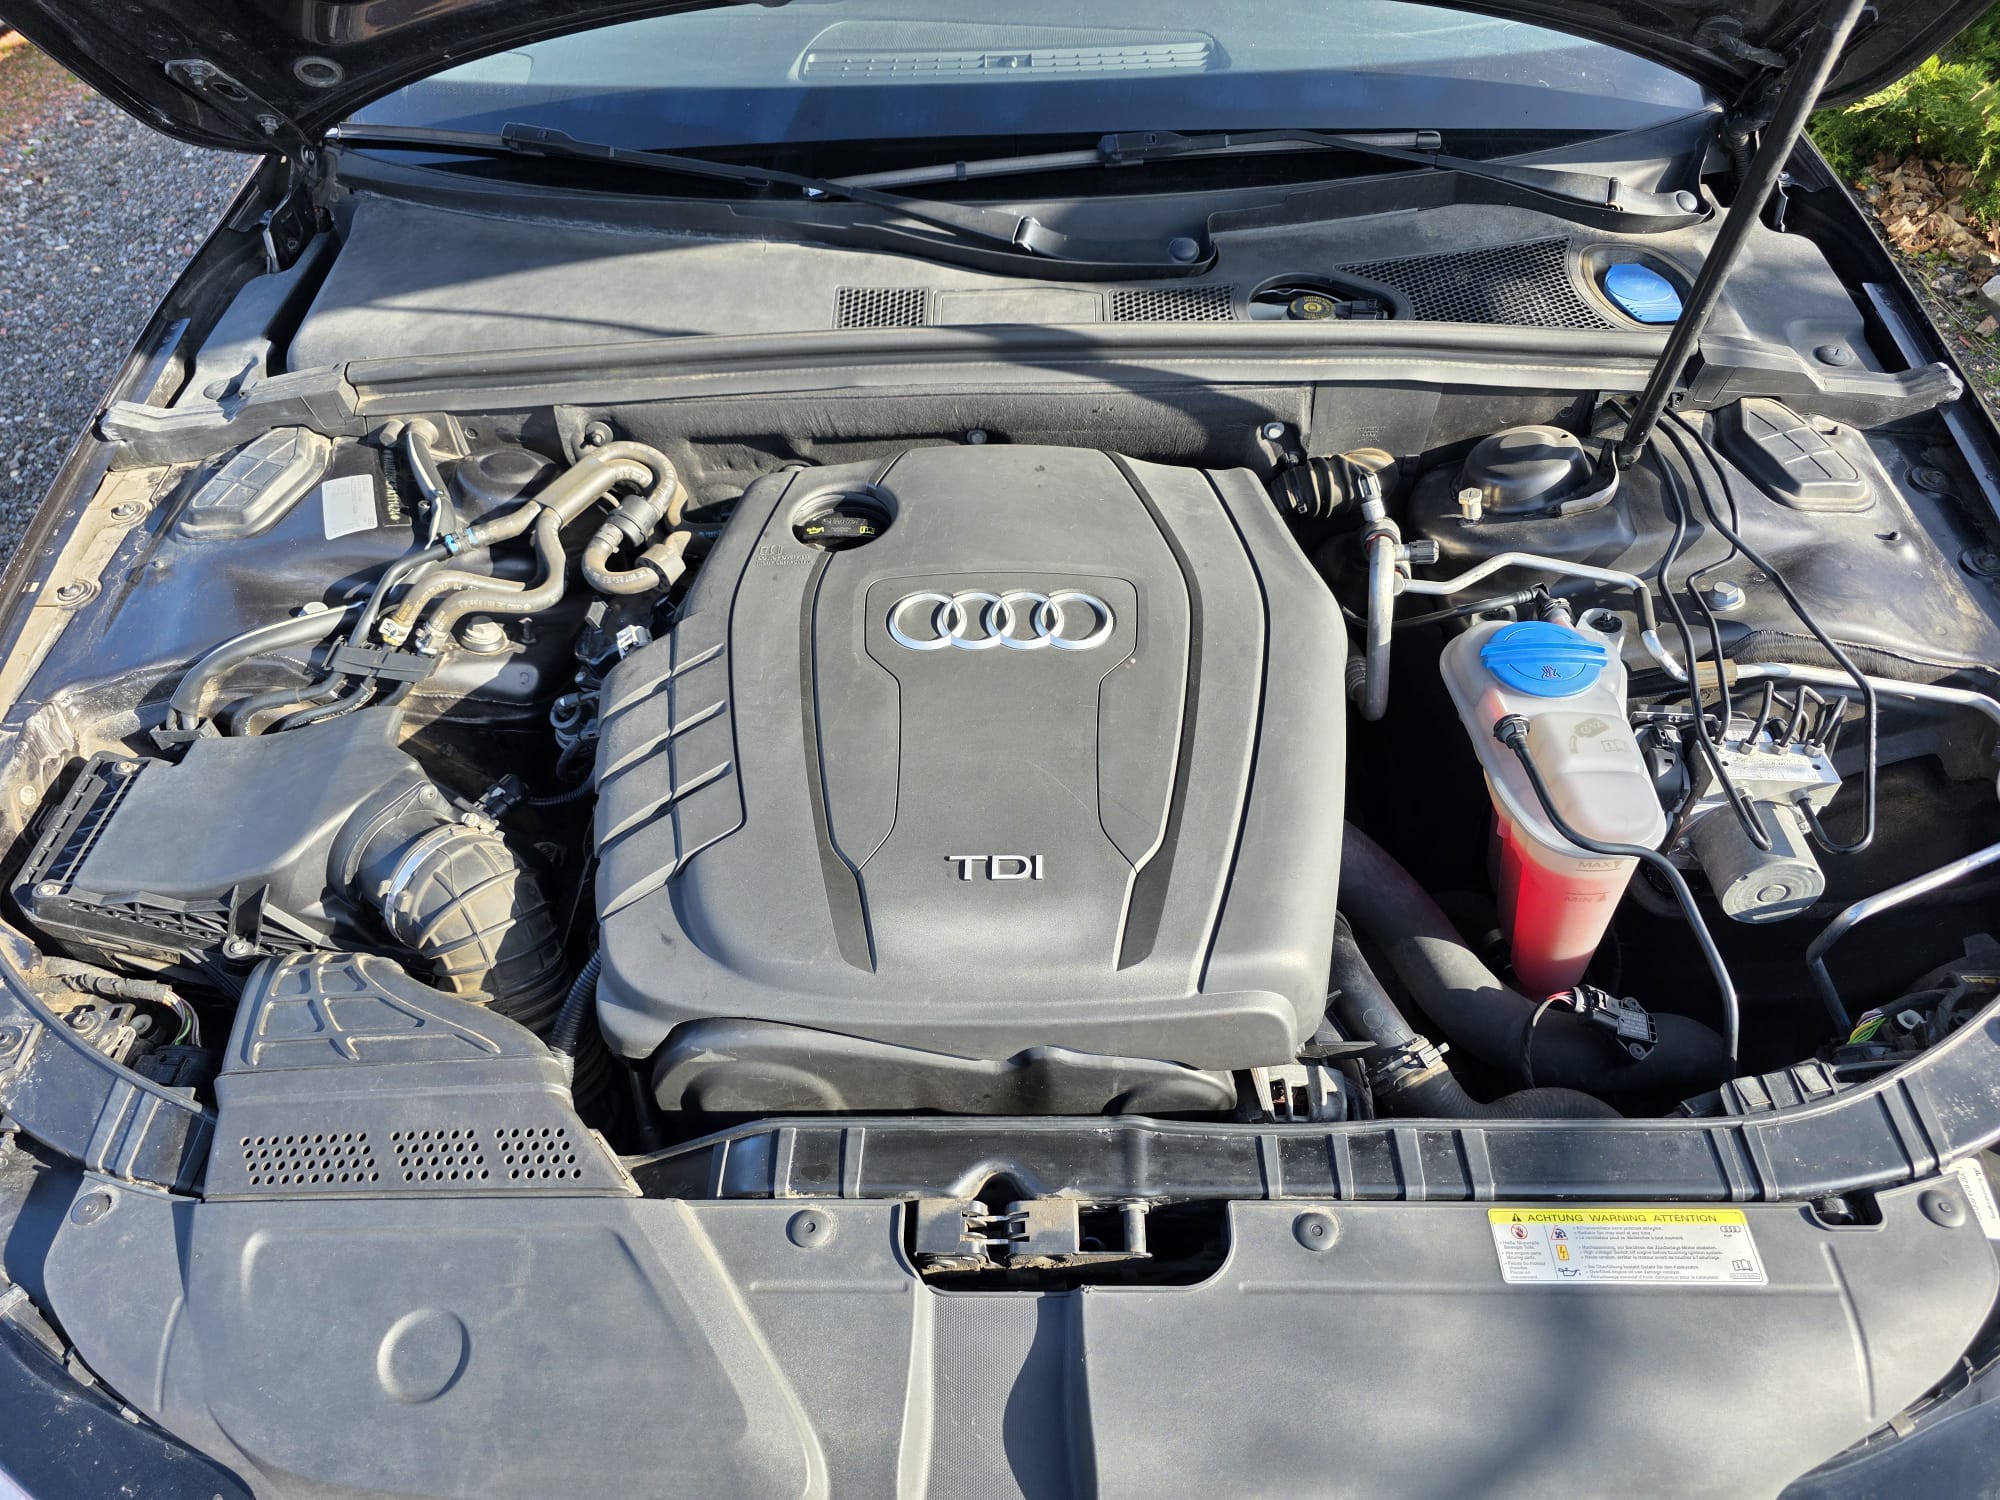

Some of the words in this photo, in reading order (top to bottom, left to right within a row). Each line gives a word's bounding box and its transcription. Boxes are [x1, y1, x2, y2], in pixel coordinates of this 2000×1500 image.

[947, 854, 1044, 881] TDI
[1578, 861, 1613, 869] MAX
[1564, 895, 1593, 903] MIN
[1527, 1214, 1583, 1222] ACHTUNG
[1589, 1214, 1647, 1222] WARNING
[1653, 1214, 1717, 1222] ATTENTION
